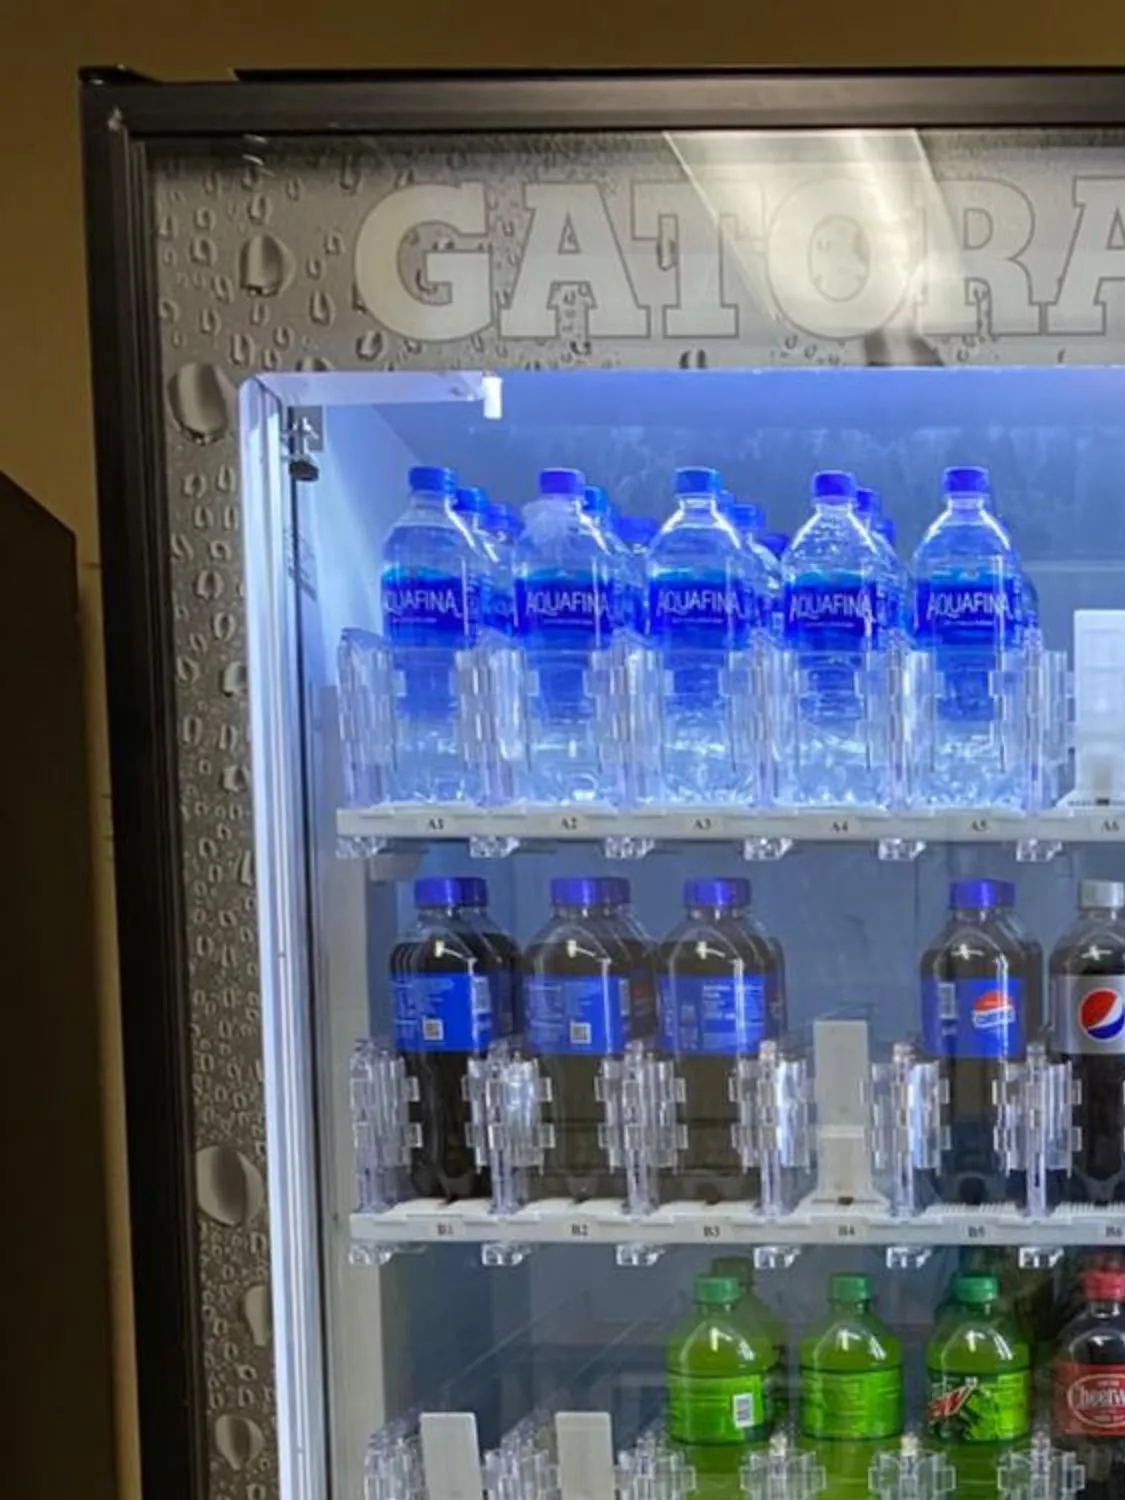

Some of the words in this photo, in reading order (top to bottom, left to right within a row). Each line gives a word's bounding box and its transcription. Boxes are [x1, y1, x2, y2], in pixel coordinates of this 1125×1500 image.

[526, 590, 610, 616] AQUAFINA
[657, 590, 741, 617] AQUAFINA
[790, 593, 875, 621] AQUAFINA
[927, 592, 1013, 619] AQUAFINA
